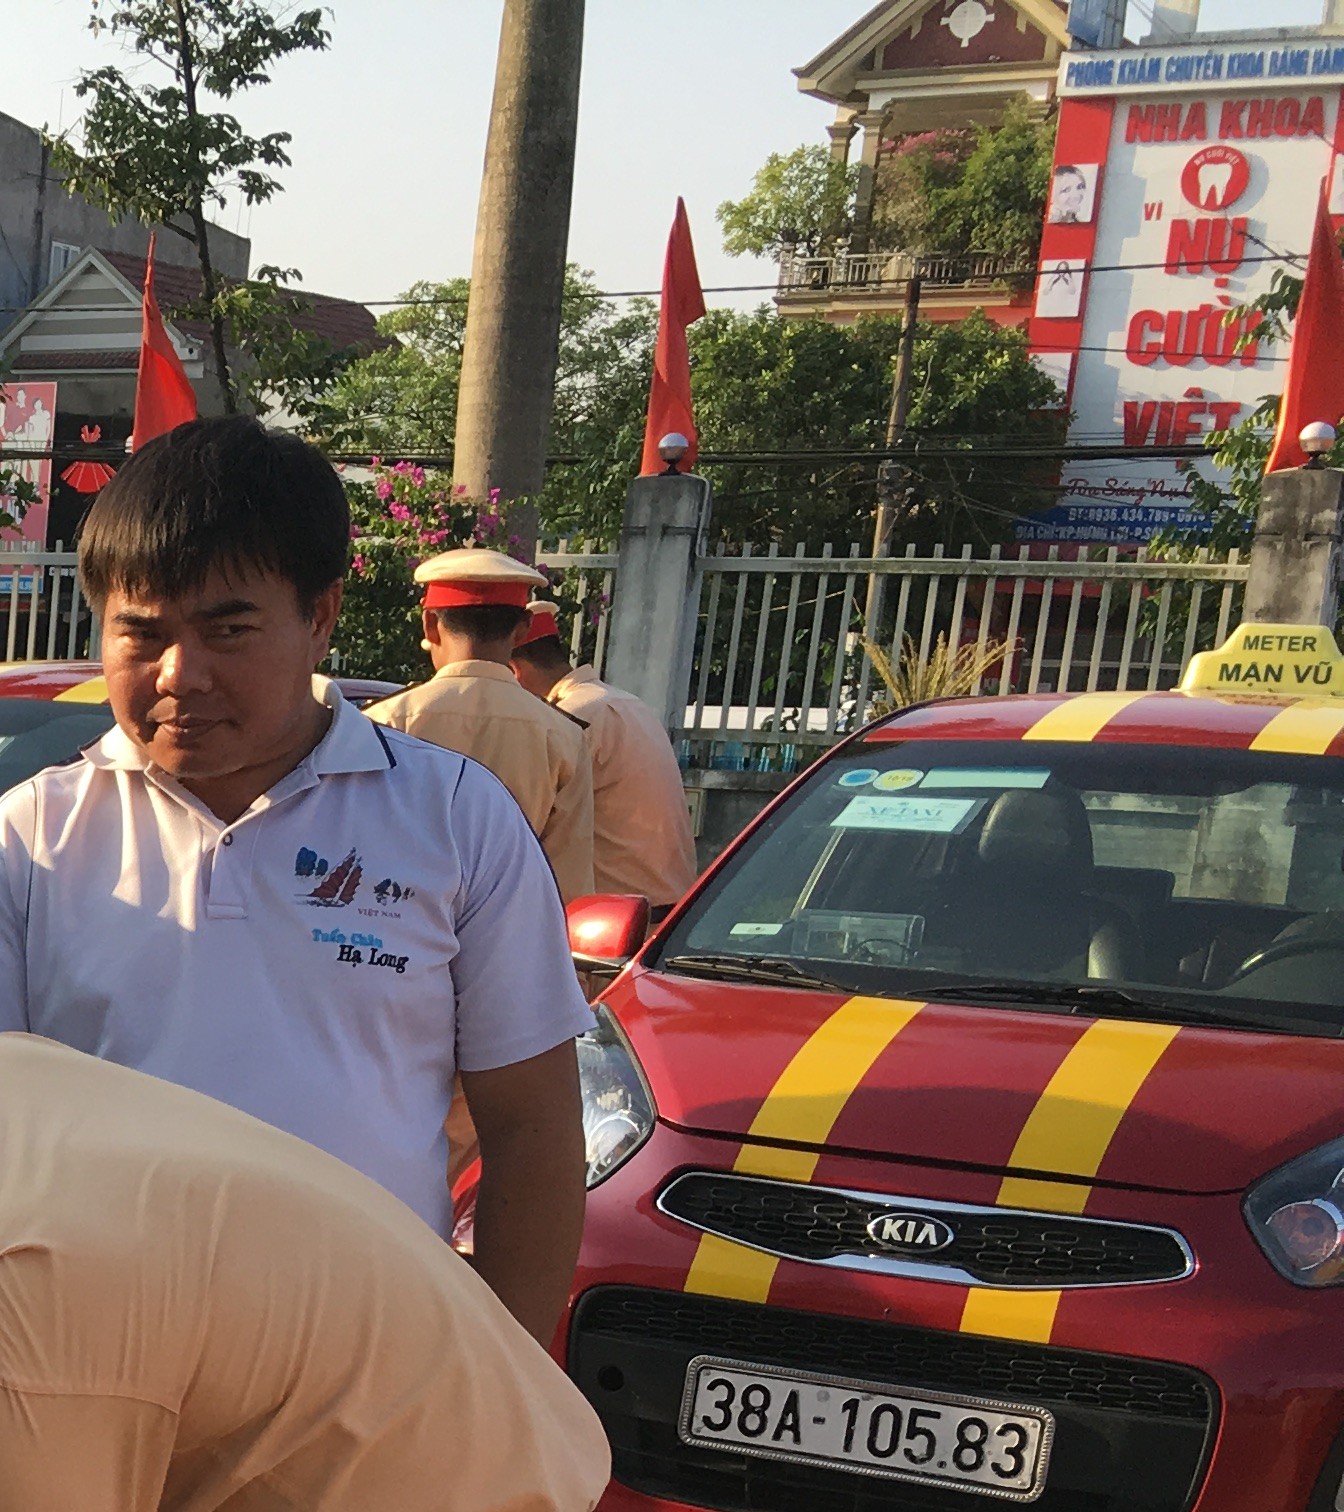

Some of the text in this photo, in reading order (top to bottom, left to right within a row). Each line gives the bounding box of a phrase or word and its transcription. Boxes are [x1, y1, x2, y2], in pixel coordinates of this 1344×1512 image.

[1125, 96, 1326, 143] NHA KHOA
[1164, 218, 1247, 288] NỤ
[1126, 294, 1263, 367] CƯỜI
[1242, 634, 1318, 652] METER
[1293, 660, 1333, 685] VŨ
[336, 943, 410, 974] Hạ Long
[881, 1216, 938, 1247] KIA
[702, 1377, 1029, 1480] 38A-105.83
